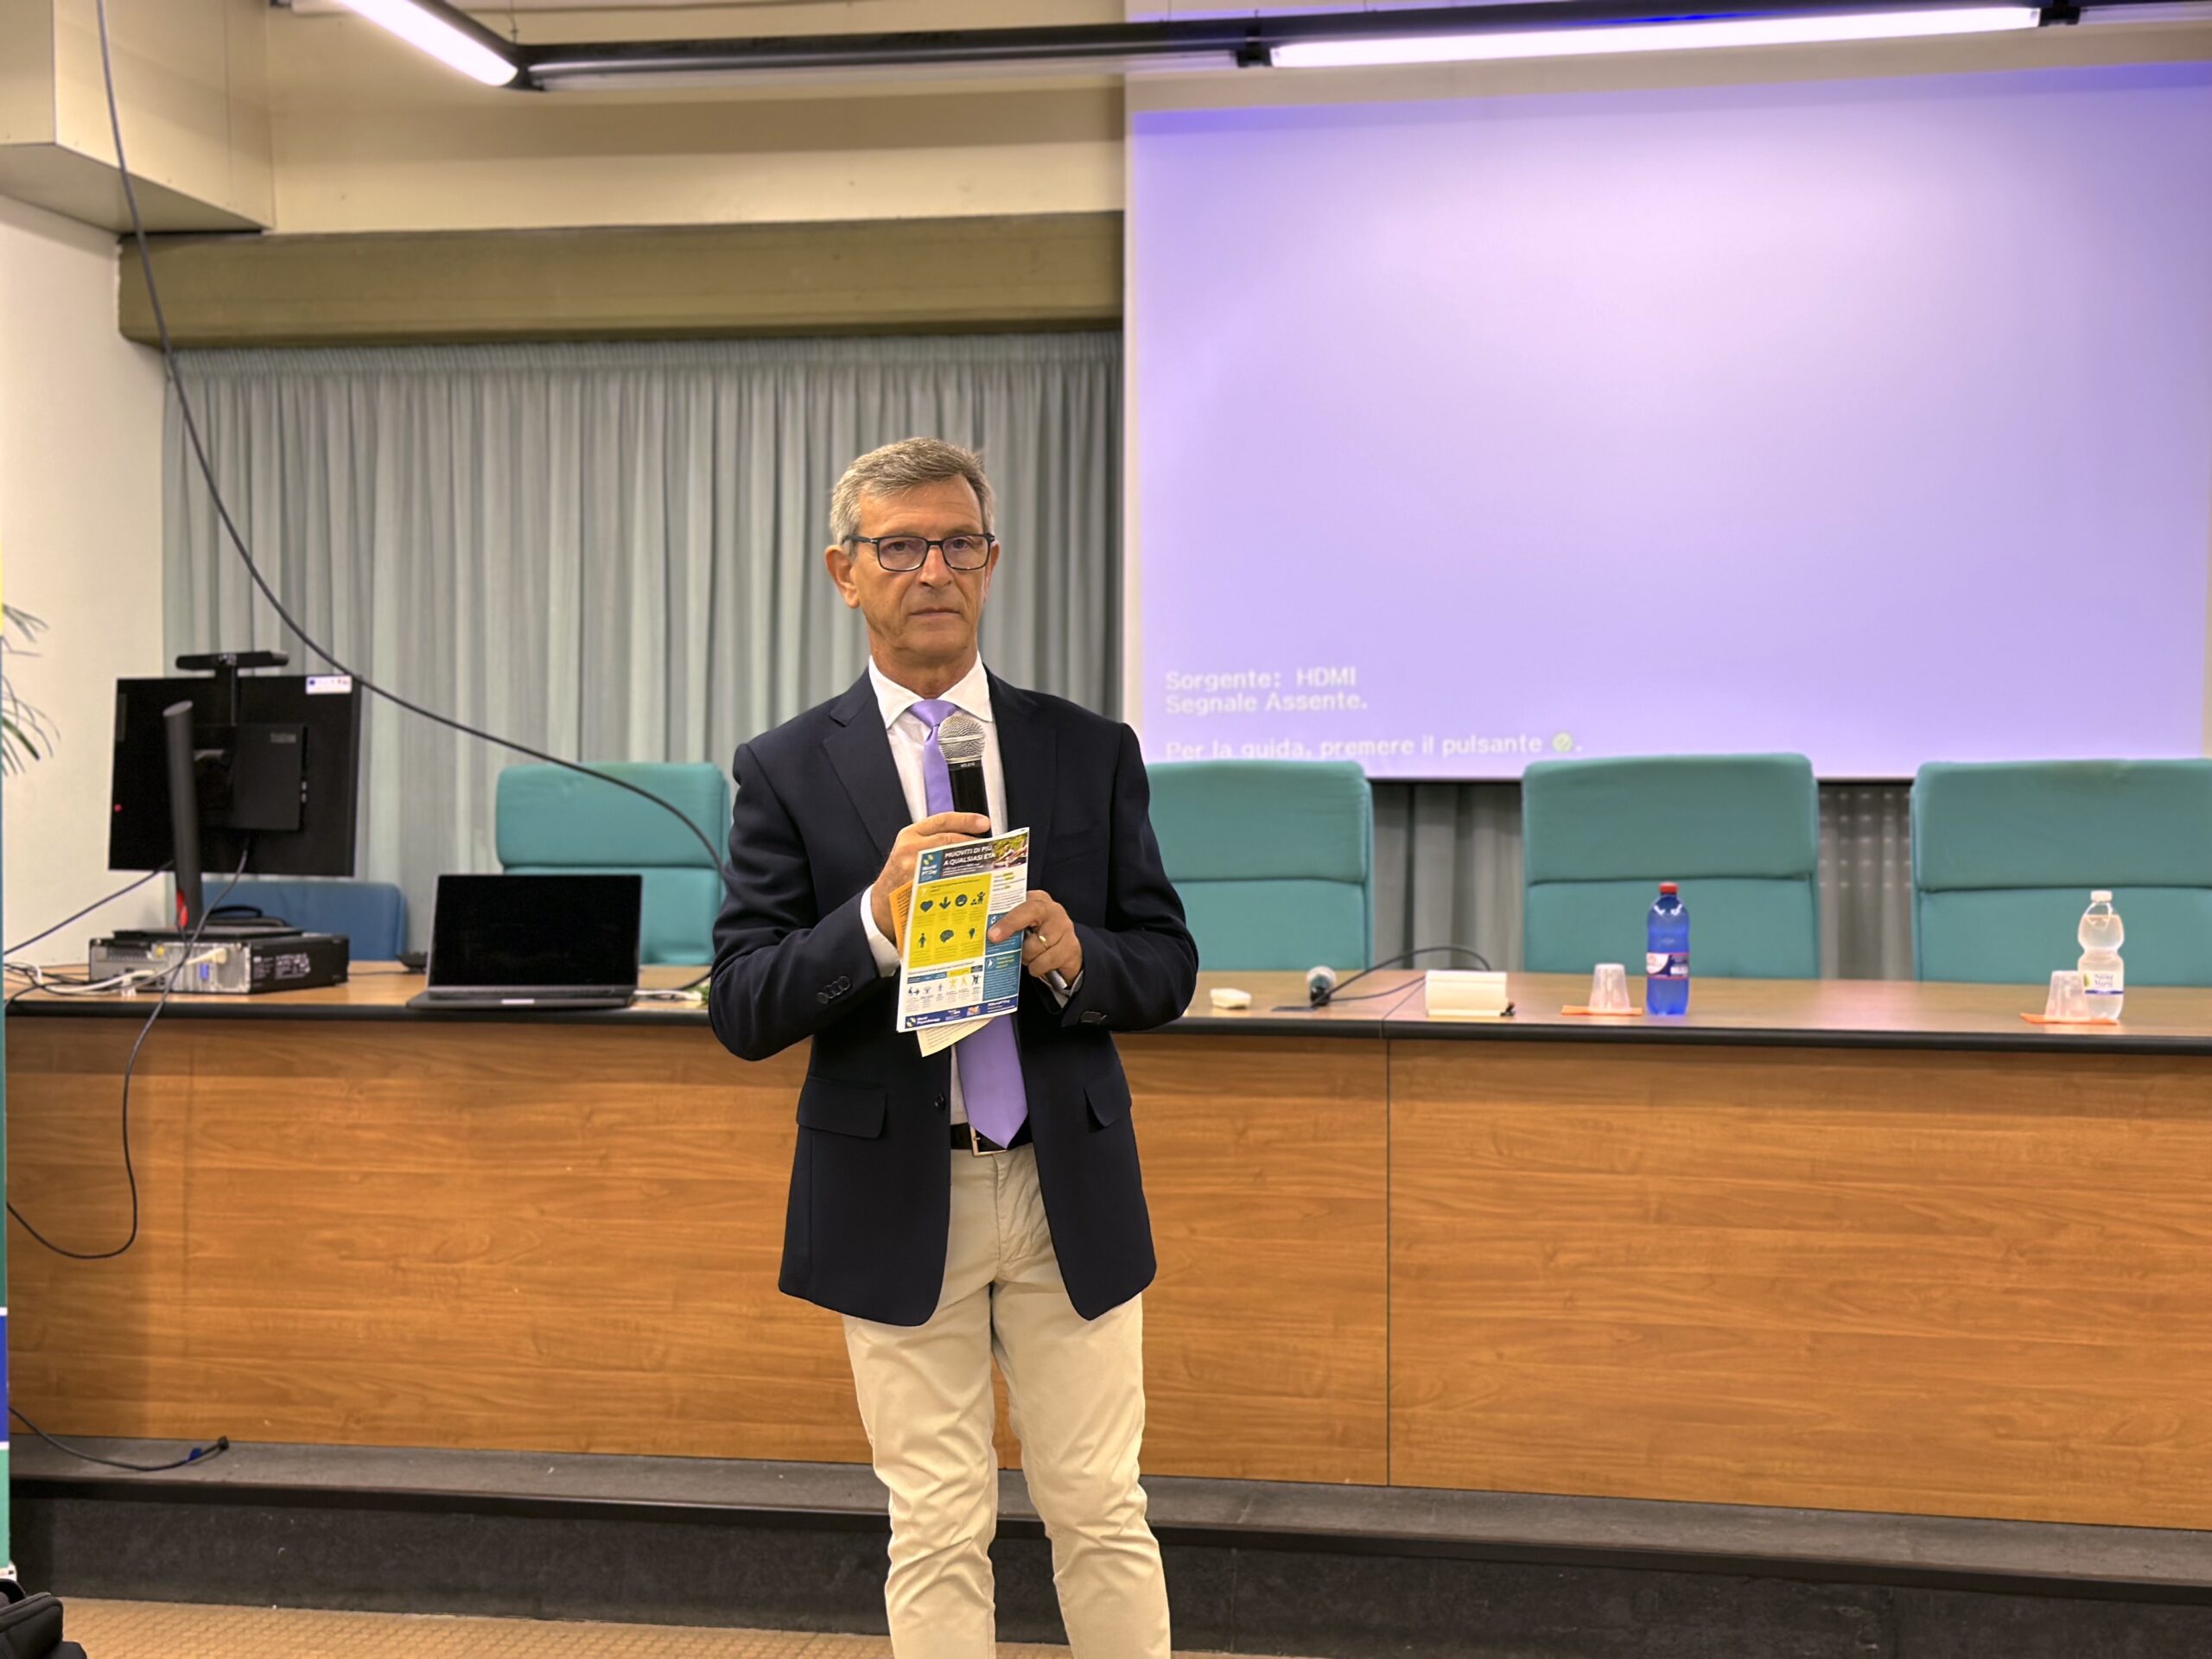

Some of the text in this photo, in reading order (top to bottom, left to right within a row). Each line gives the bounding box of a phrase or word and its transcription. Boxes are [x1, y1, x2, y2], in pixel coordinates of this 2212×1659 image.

[1166, 667, 1357, 692] Sorgente: HDMI
[1166, 691, 1368, 716] Segnale Assente.
[1166, 741, 1205, 760] Per
[1212, 739, 1232, 760] la
[1319, 737, 1414, 760] premere
[1422, 735, 1434, 756] il
[1442, 734, 1542, 758] pulsante
